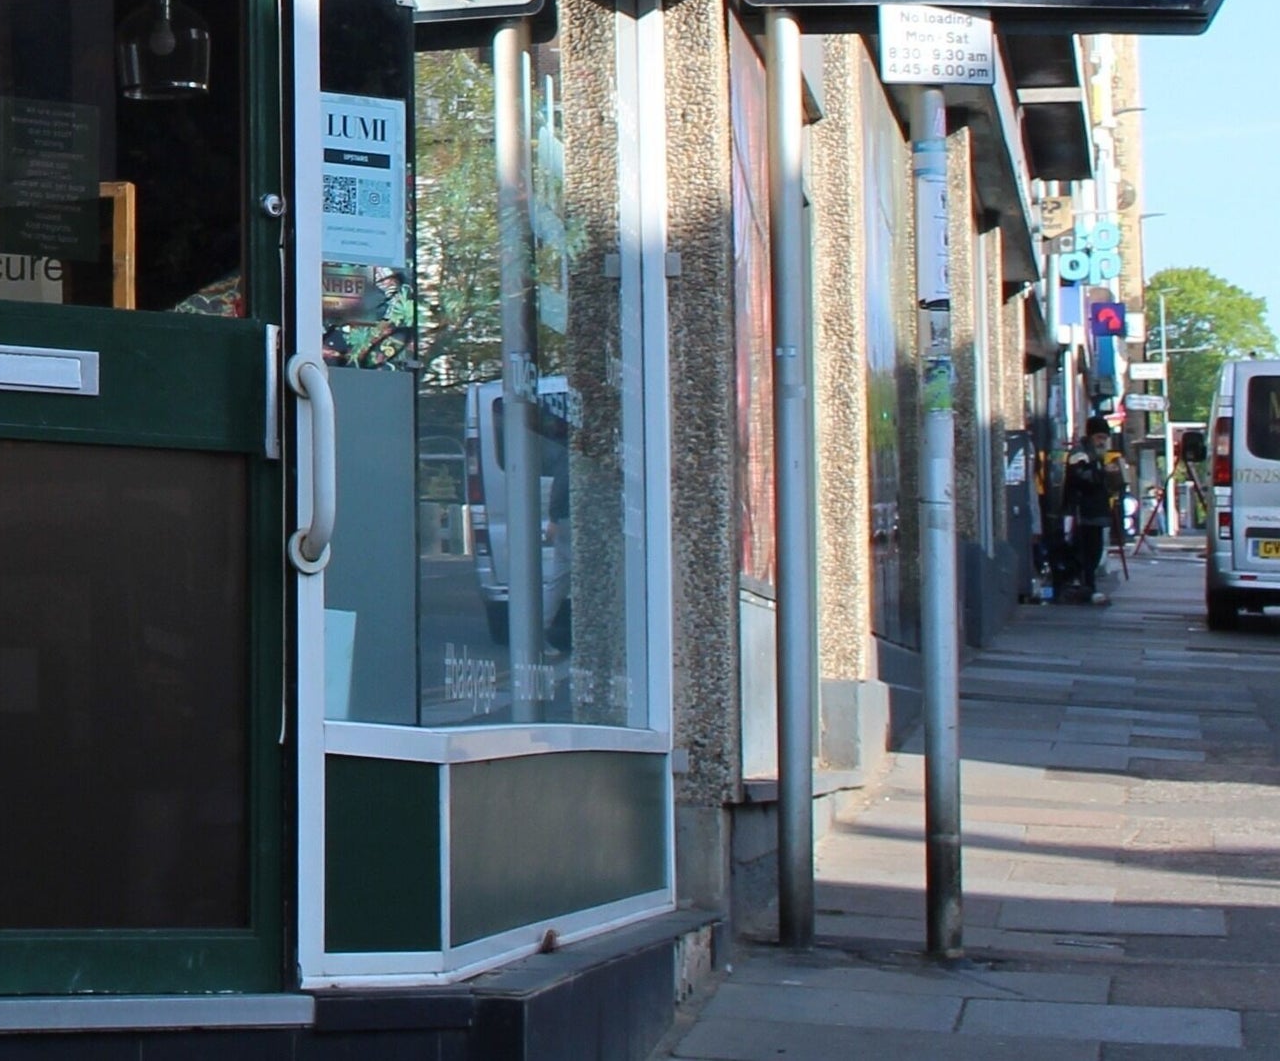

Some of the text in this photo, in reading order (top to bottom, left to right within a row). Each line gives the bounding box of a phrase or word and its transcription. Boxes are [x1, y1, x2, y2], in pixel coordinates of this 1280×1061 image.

[900, 11, 973, 27] No loading
[906, 30, 935, 43] Mon
[946, 31, 970, 44] Sat
[932, 48, 965, 61] 9.30
[968, 52, 988, 62] am
[932, 64, 965, 76] 6.00
[968, 67, 988, 79] pm
[327, 113, 388, 142] LUMI
